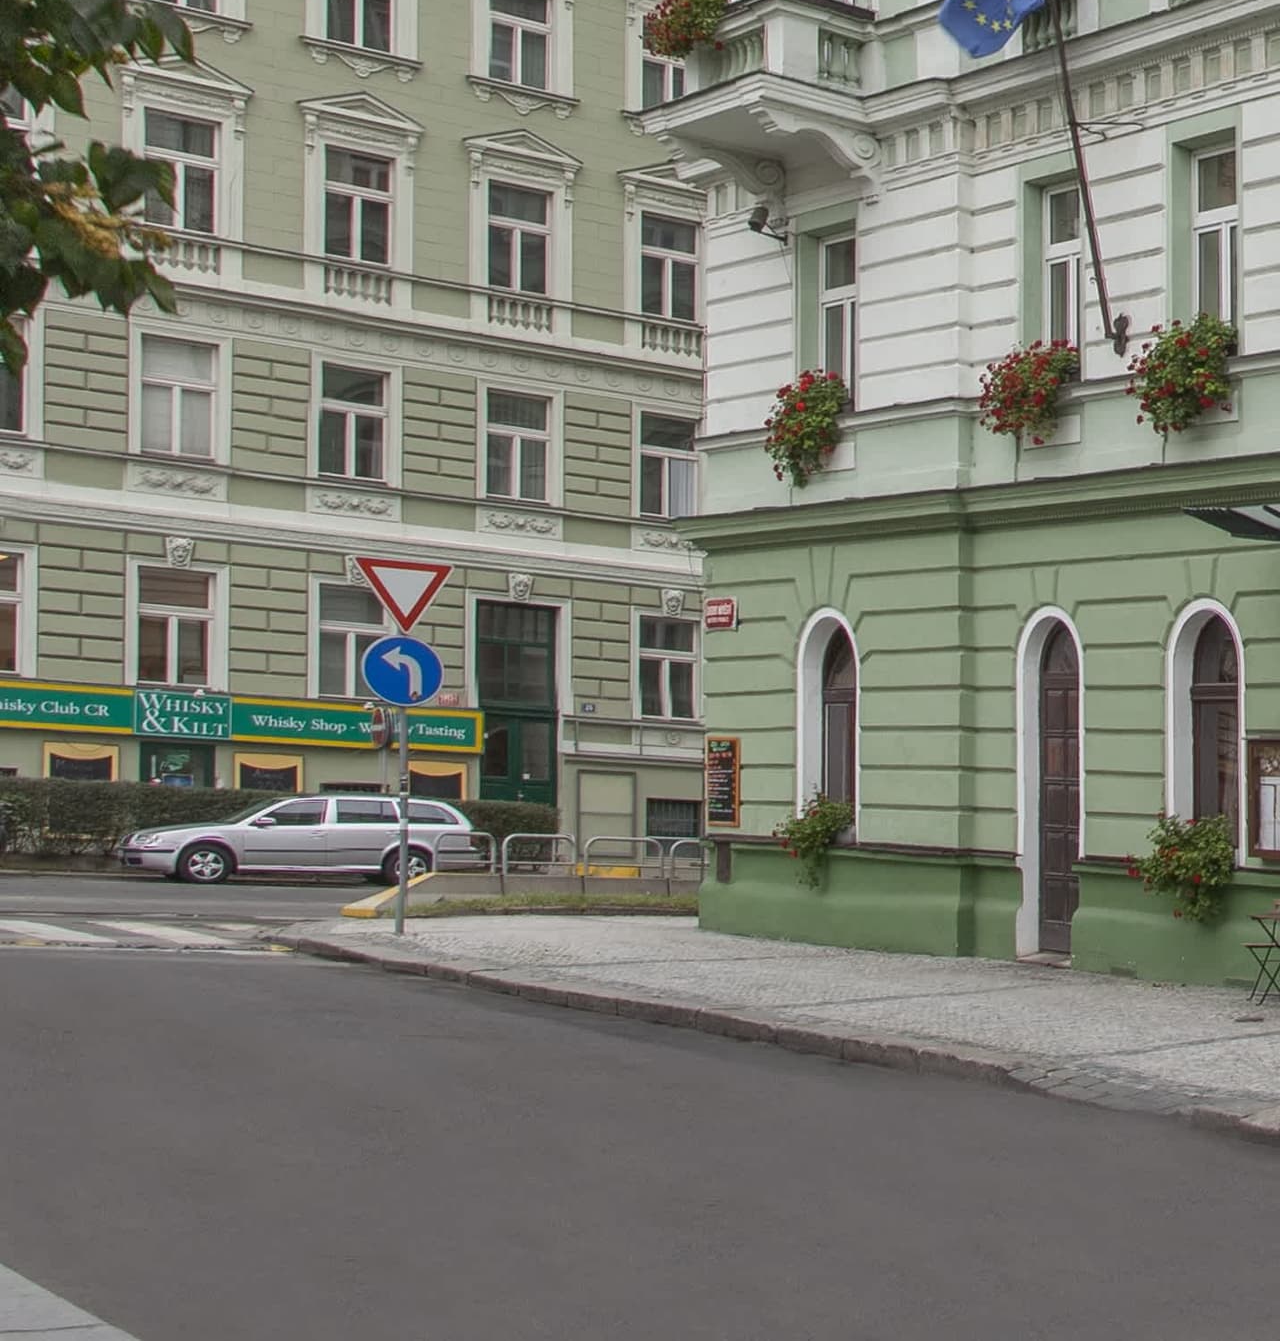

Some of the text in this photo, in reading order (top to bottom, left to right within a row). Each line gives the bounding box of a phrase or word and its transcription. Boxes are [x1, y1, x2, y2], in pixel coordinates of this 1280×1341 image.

[0, 699, 110, 716] isky Club CR
[142, 708, 171, 733] &
[252, 715, 306, 731] Whisky
[311, 719, 347, 734] Shop
[416, 723, 466, 739] Tasting
